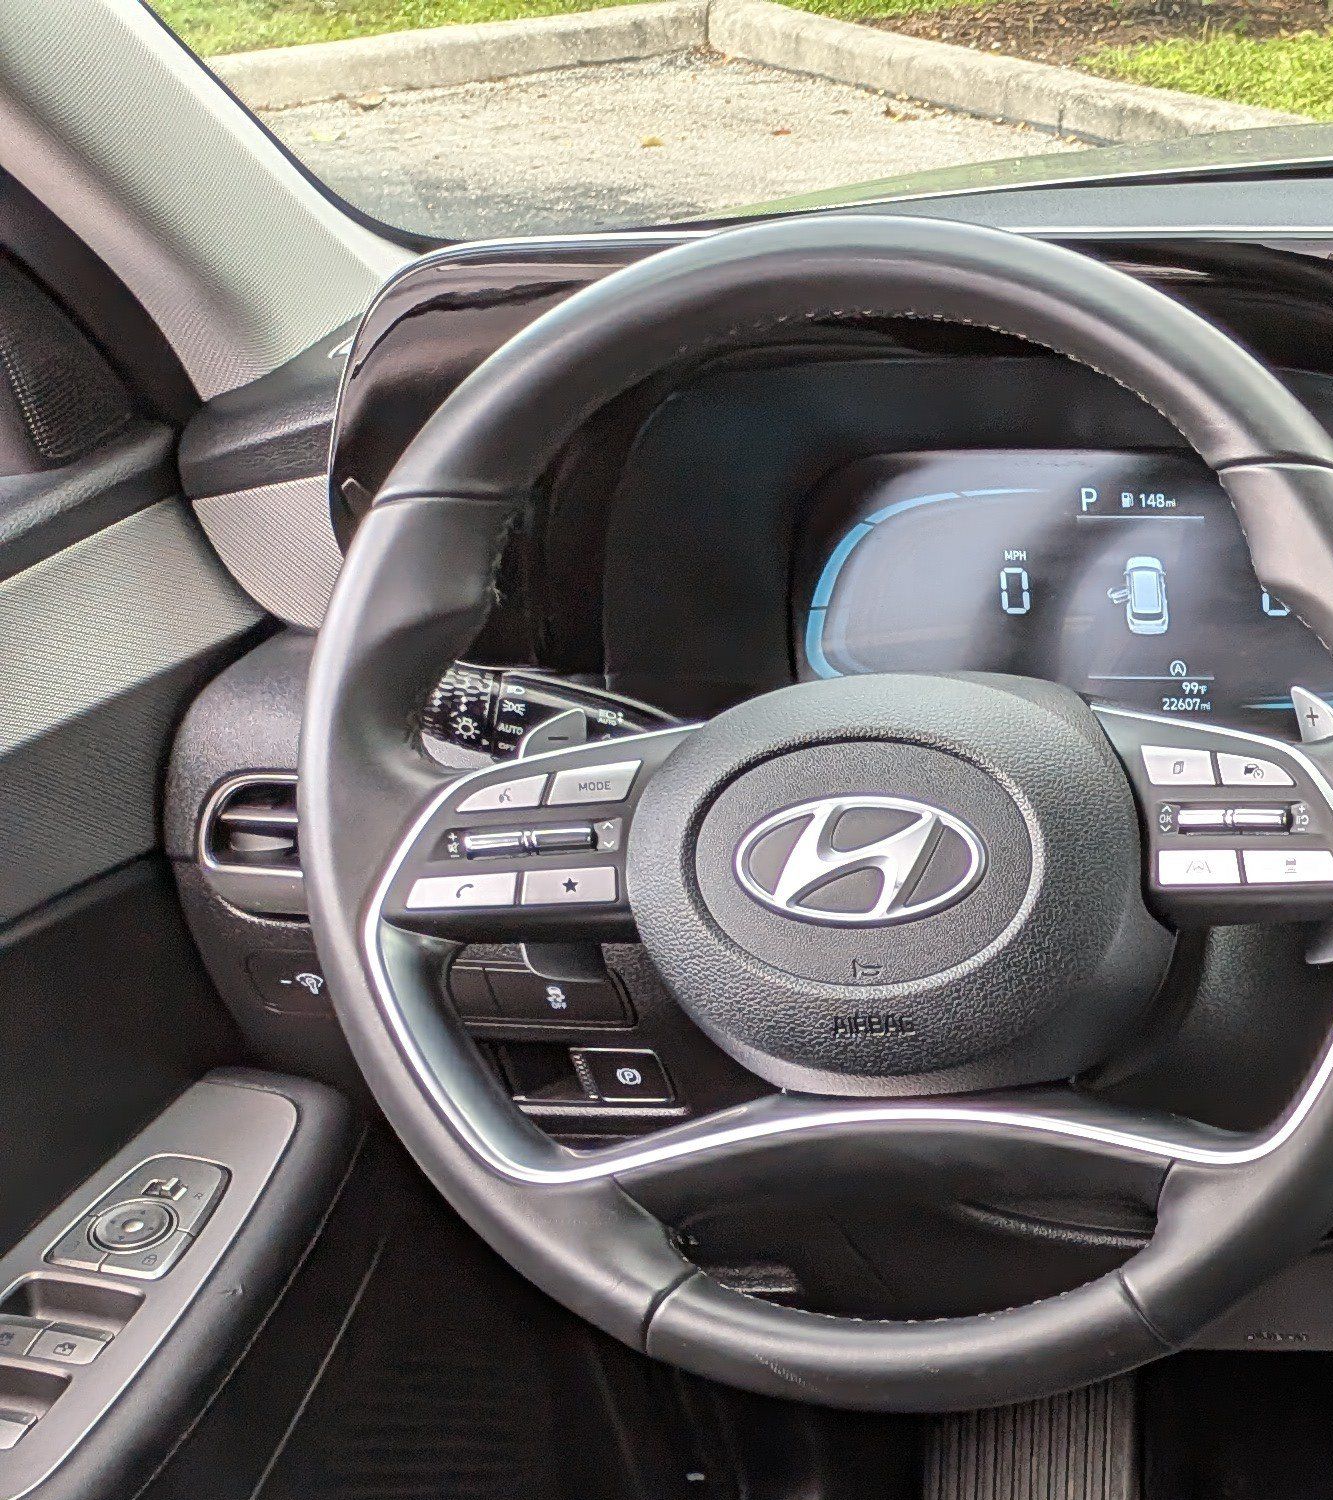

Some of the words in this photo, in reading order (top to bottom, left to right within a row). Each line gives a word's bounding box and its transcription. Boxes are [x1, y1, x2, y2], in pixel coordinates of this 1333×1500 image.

[1080, 487, 1098, 512] P
[1004, 549, 1027, 561] MPH
[1000, 567, 1030, 615] 0
[497, 721, 524, 736] AUTO
[578, 780, 612, 792] MODE
[1158, 814, 1173, 825] OK
